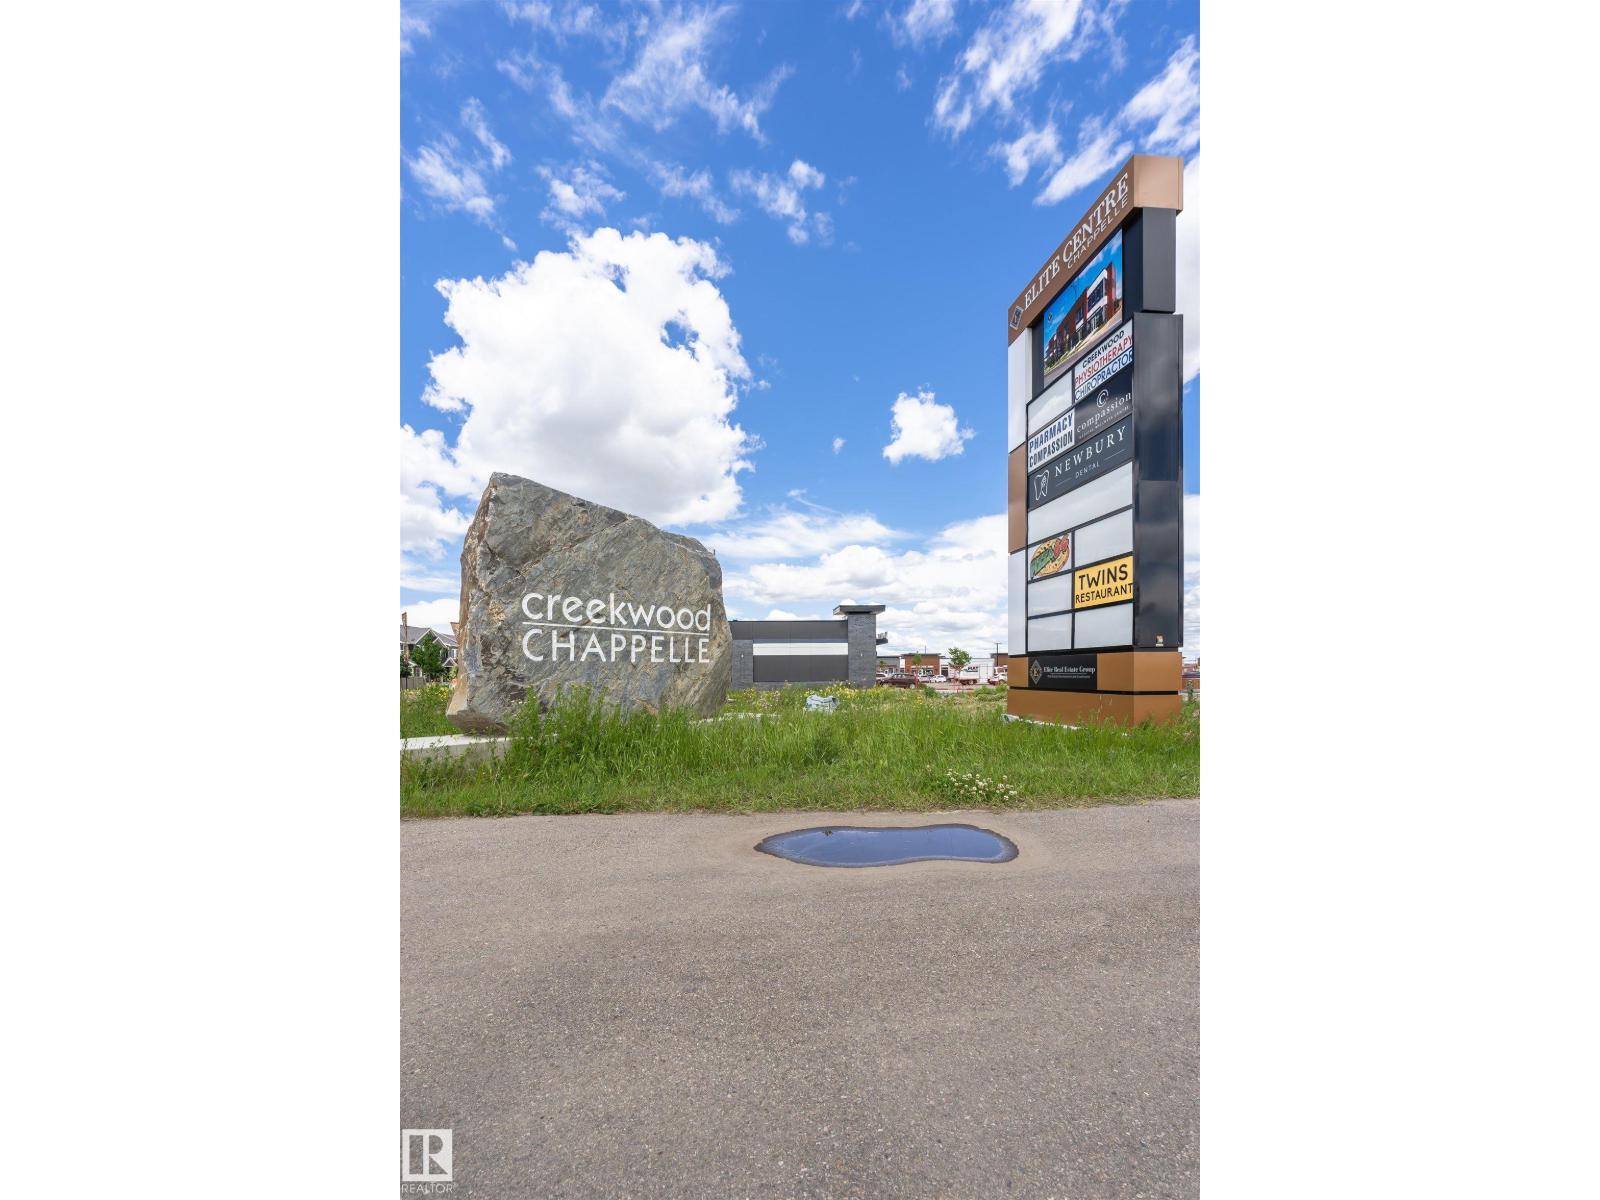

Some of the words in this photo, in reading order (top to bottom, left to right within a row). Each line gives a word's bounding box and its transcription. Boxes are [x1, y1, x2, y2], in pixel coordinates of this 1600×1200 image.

[1024, 256, 1060, 311] ELITE
[1062, 172, 1129, 263] CENTRE
[1067, 194, 1128, 269] CHAPPELLE
[1075, 335, 1132, 385] PHYSIOTHERAPY
[1082, 330, 1124, 368] CREEKWOOD
[1075, 349, 1132, 401] CHIROPRACTOR
[1029, 413, 1073, 453] PHARMACY
[1077, 393, 1131, 433] compassion
[1029, 429, 1073, 468] COMPASSION
[1055, 425, 1126, 477] NEWBURY
[1075, 461, 1100, 479] DENTAL
[1075, 582, 1133, 604] RESTAURANT
[1078, 563, 1128, 591] TWINS
[521, 592, 712, 632] creekwood
[522, 628, 710, 663] CHAPPELLE
[1079, 665, 1096, 674] Group
